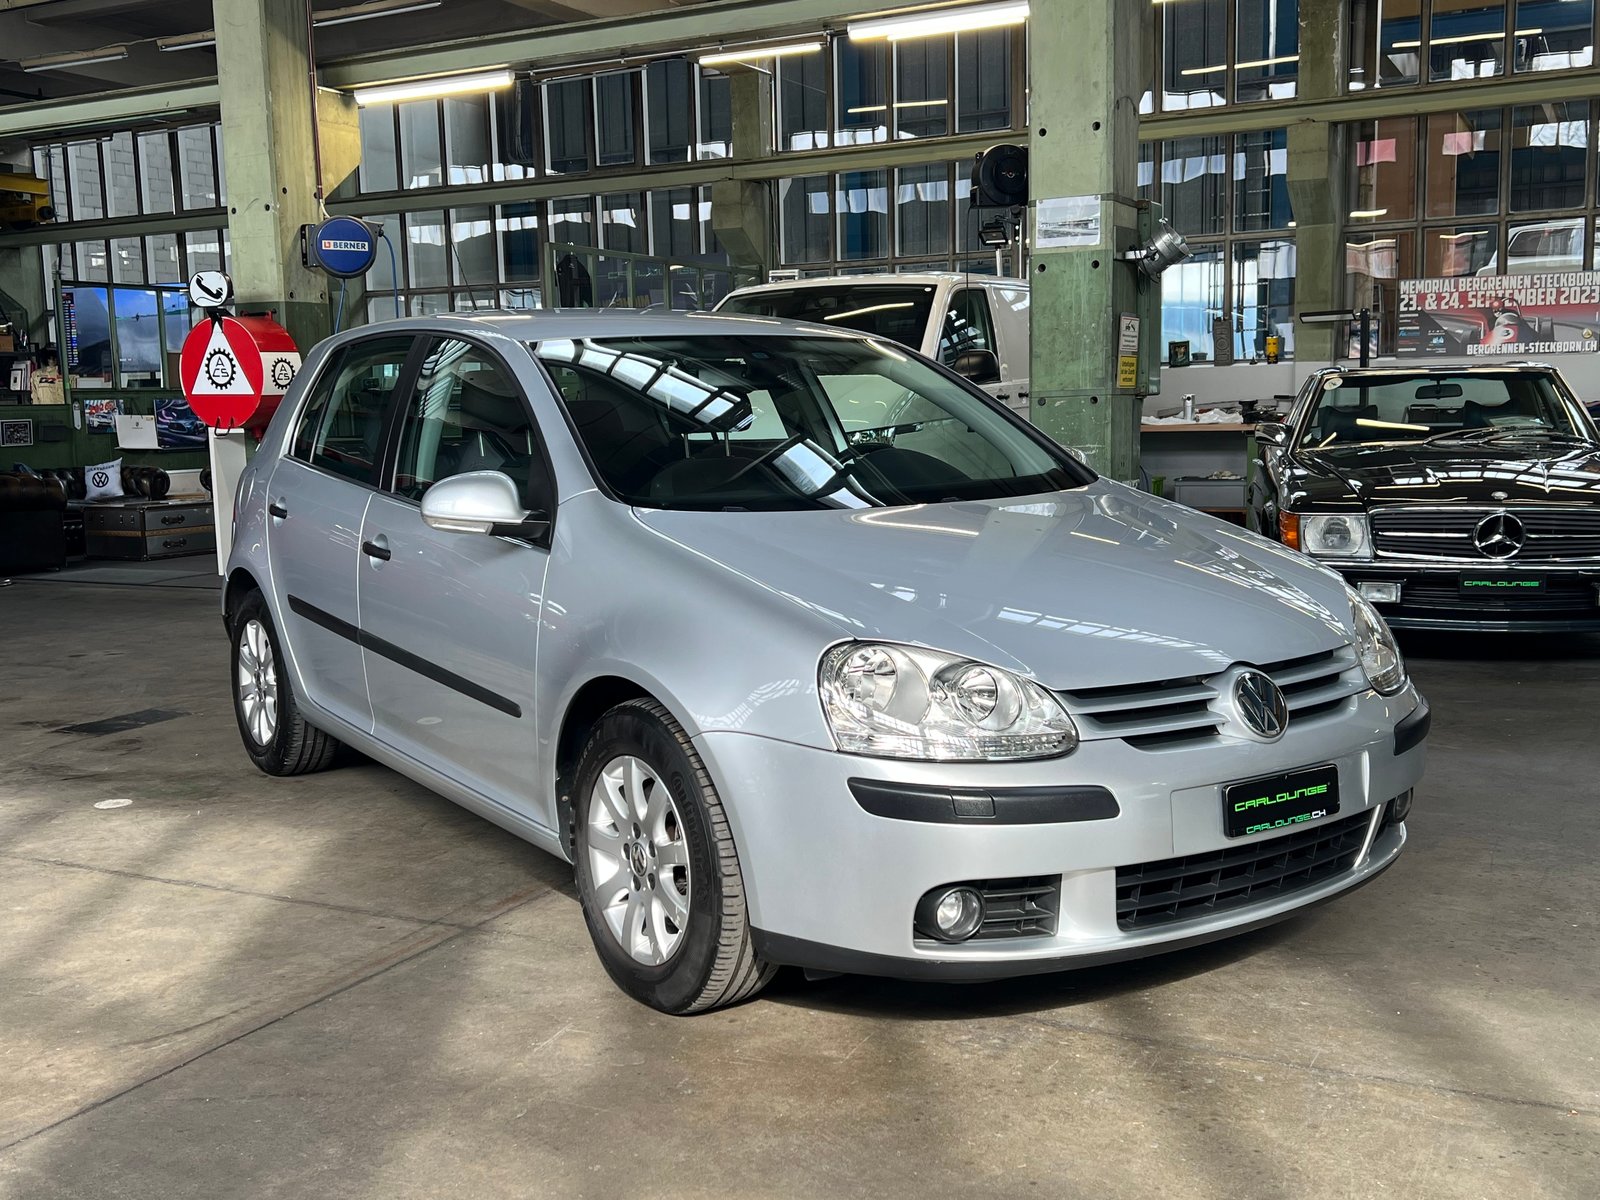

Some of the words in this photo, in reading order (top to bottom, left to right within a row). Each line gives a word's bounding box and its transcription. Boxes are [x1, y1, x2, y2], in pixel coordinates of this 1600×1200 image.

[333, 241, 366, 250] BERNER
[1400, 279, 1456, 294] MEMORIAL
[1458, 275, 1531, 292] BERGRENNEN
[1533, 272, 1600, 288] STECKBORN
[1400, 294, 1422, 311] 23.
[1425, 293, 1437, 310] &
[1440, 292, 1464, 309] 24.
[1467, 288, 1557, 308] SEPTEMBER
[1560, 286, 1600, 304] 2023
[1467, 341, 1598, 355] BERGRENNEN-STECKBORN.CH
[1234, 784, 1328, 812] CARLOUNGE
[1246, 809, 1327, 834] CARLOUNGE.CH
